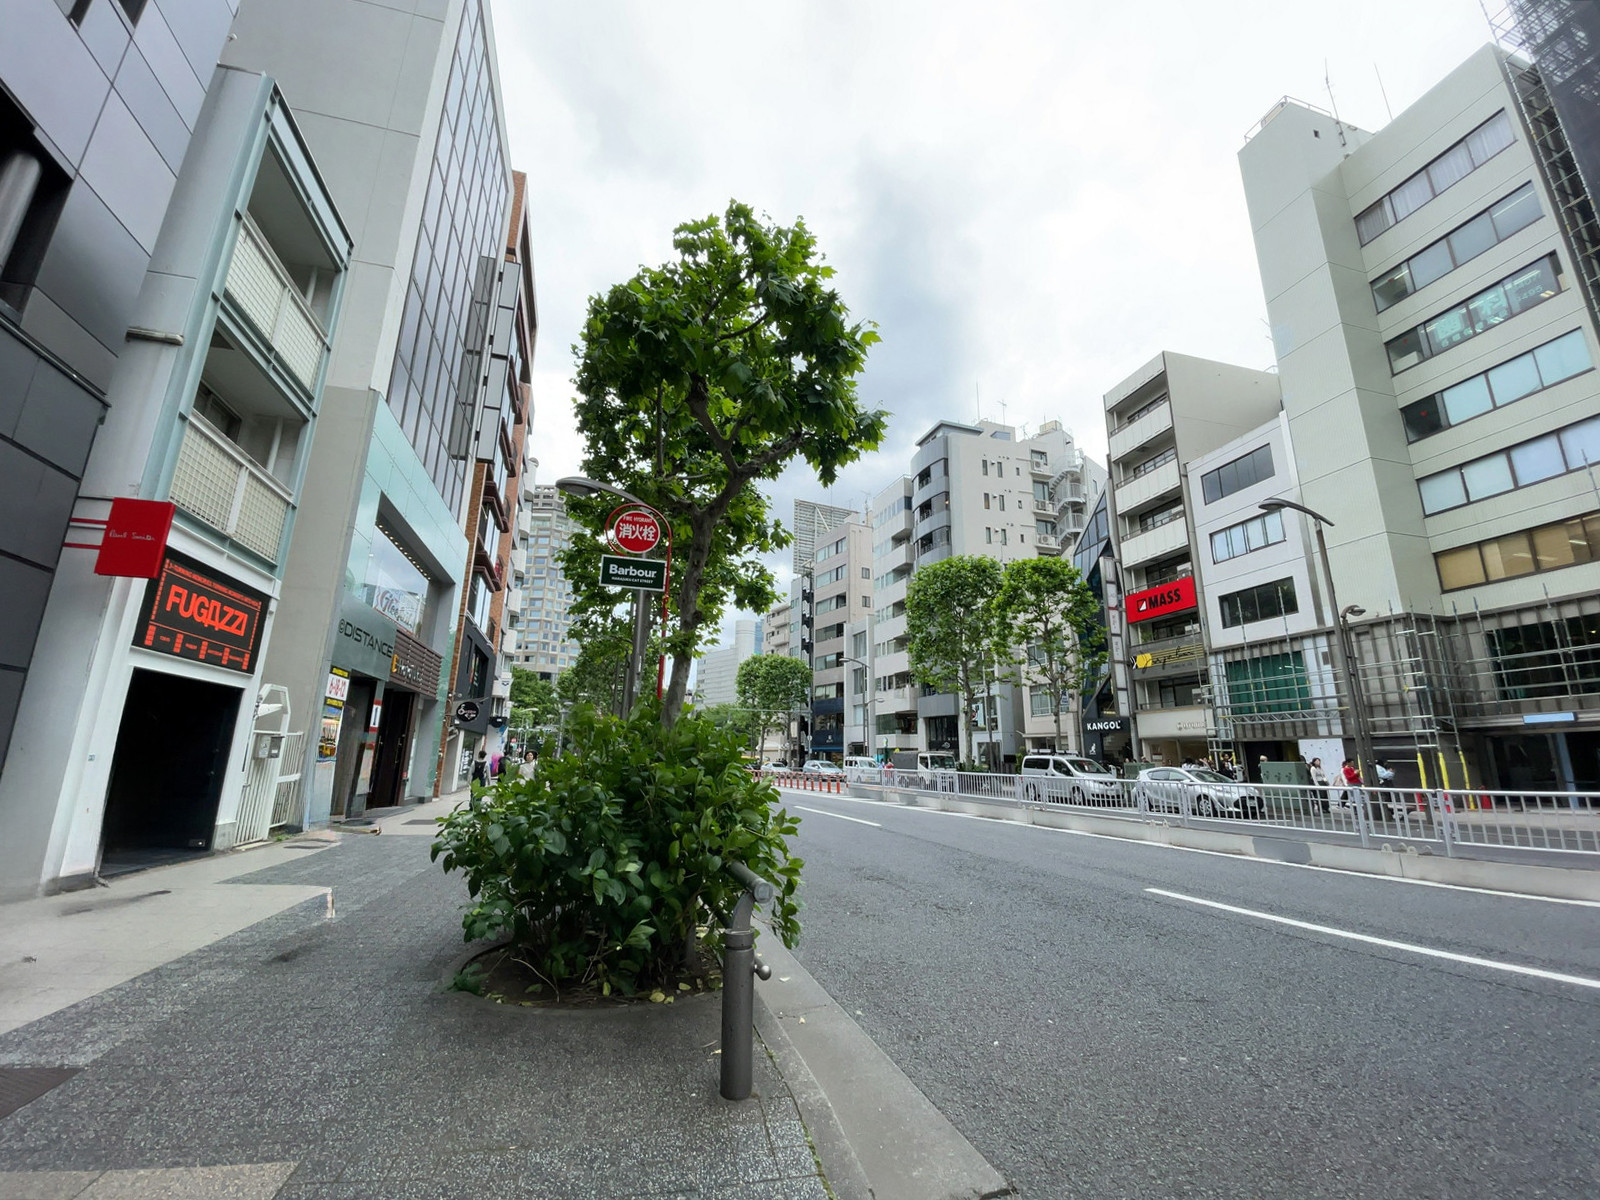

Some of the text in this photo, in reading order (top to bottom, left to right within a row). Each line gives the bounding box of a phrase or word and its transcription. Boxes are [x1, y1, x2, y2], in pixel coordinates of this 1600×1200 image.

[109, 529, 128, 538] Paul
[618, 522, 656, 542] 消火栓
[609, 563, 657, 578] Barbour
[1148, 588, 1182, 609] MASS
[166, 584, 248, 637] FUGAZZI
[1087, 721, 1121, 731] KANGOL
